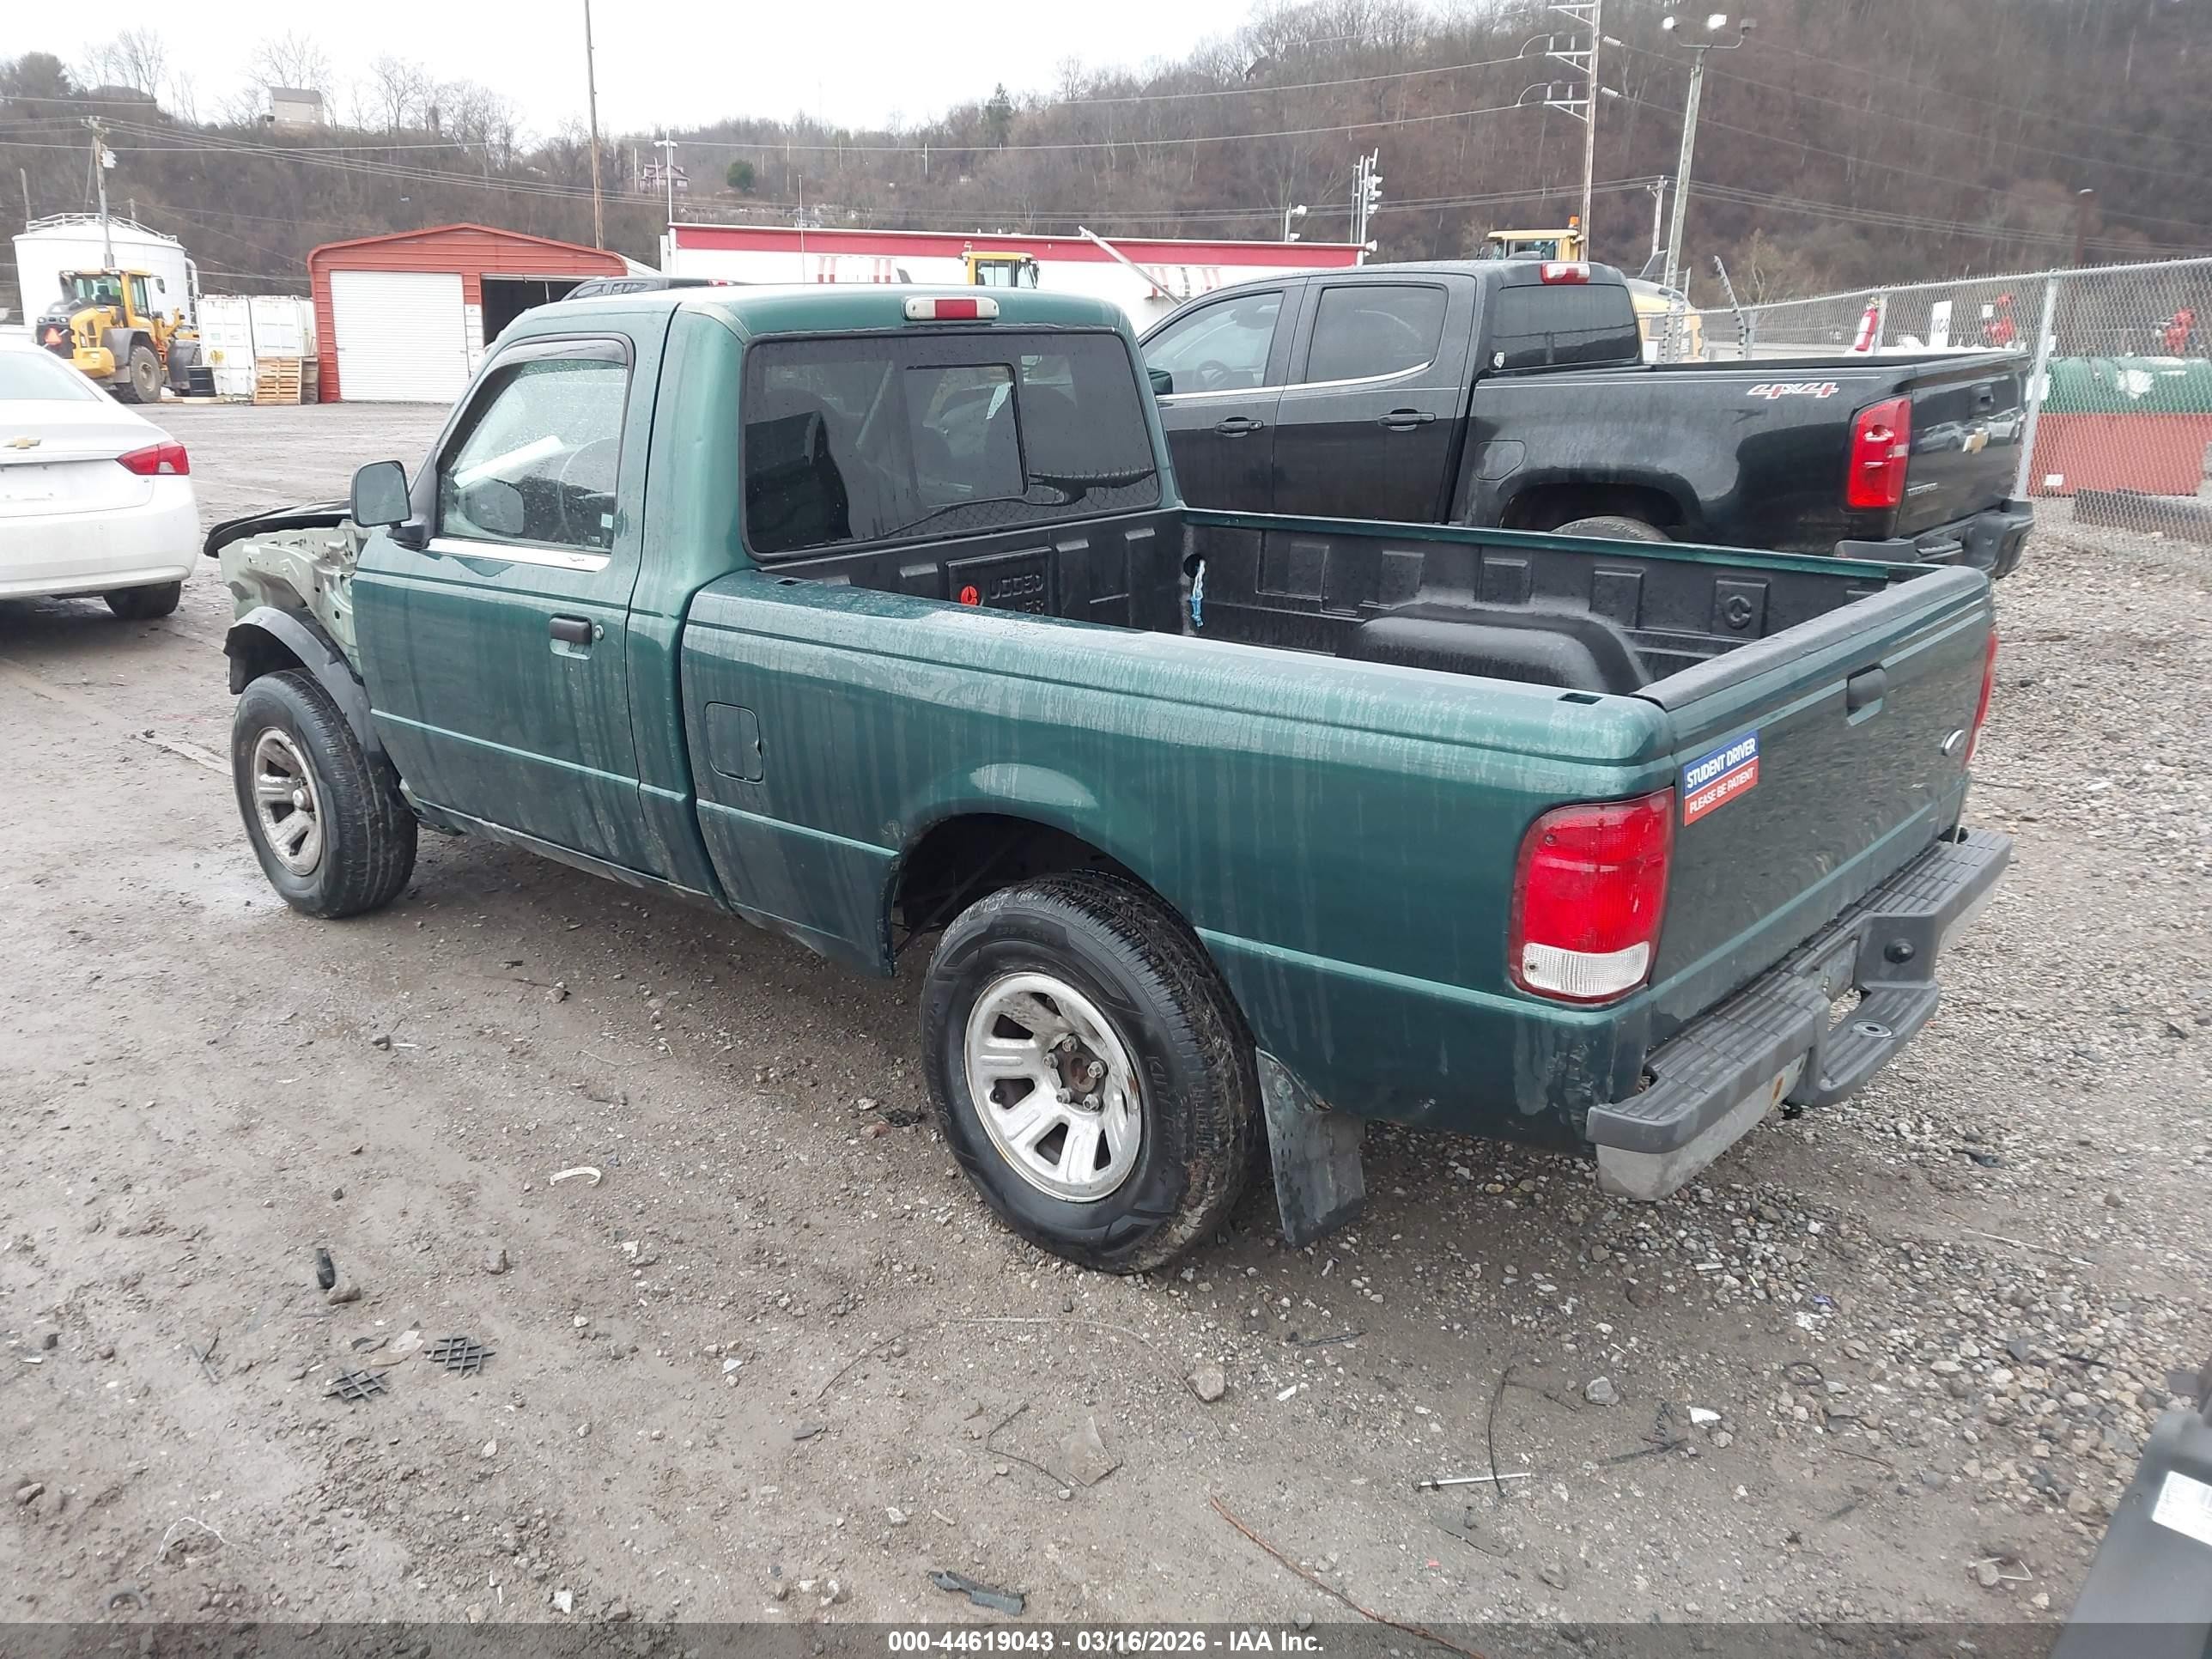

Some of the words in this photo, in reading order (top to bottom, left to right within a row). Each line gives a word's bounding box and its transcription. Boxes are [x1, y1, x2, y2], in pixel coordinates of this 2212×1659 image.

[1686, 754, 1726, 789] STUDENT
[1726, 738, 1756, 767] DRIVER
[1689, 789, 1717, 814] PLEASE
[1717, 783, 1728, 798] BE
[1727, 767, 1755, 792] PATIENT
